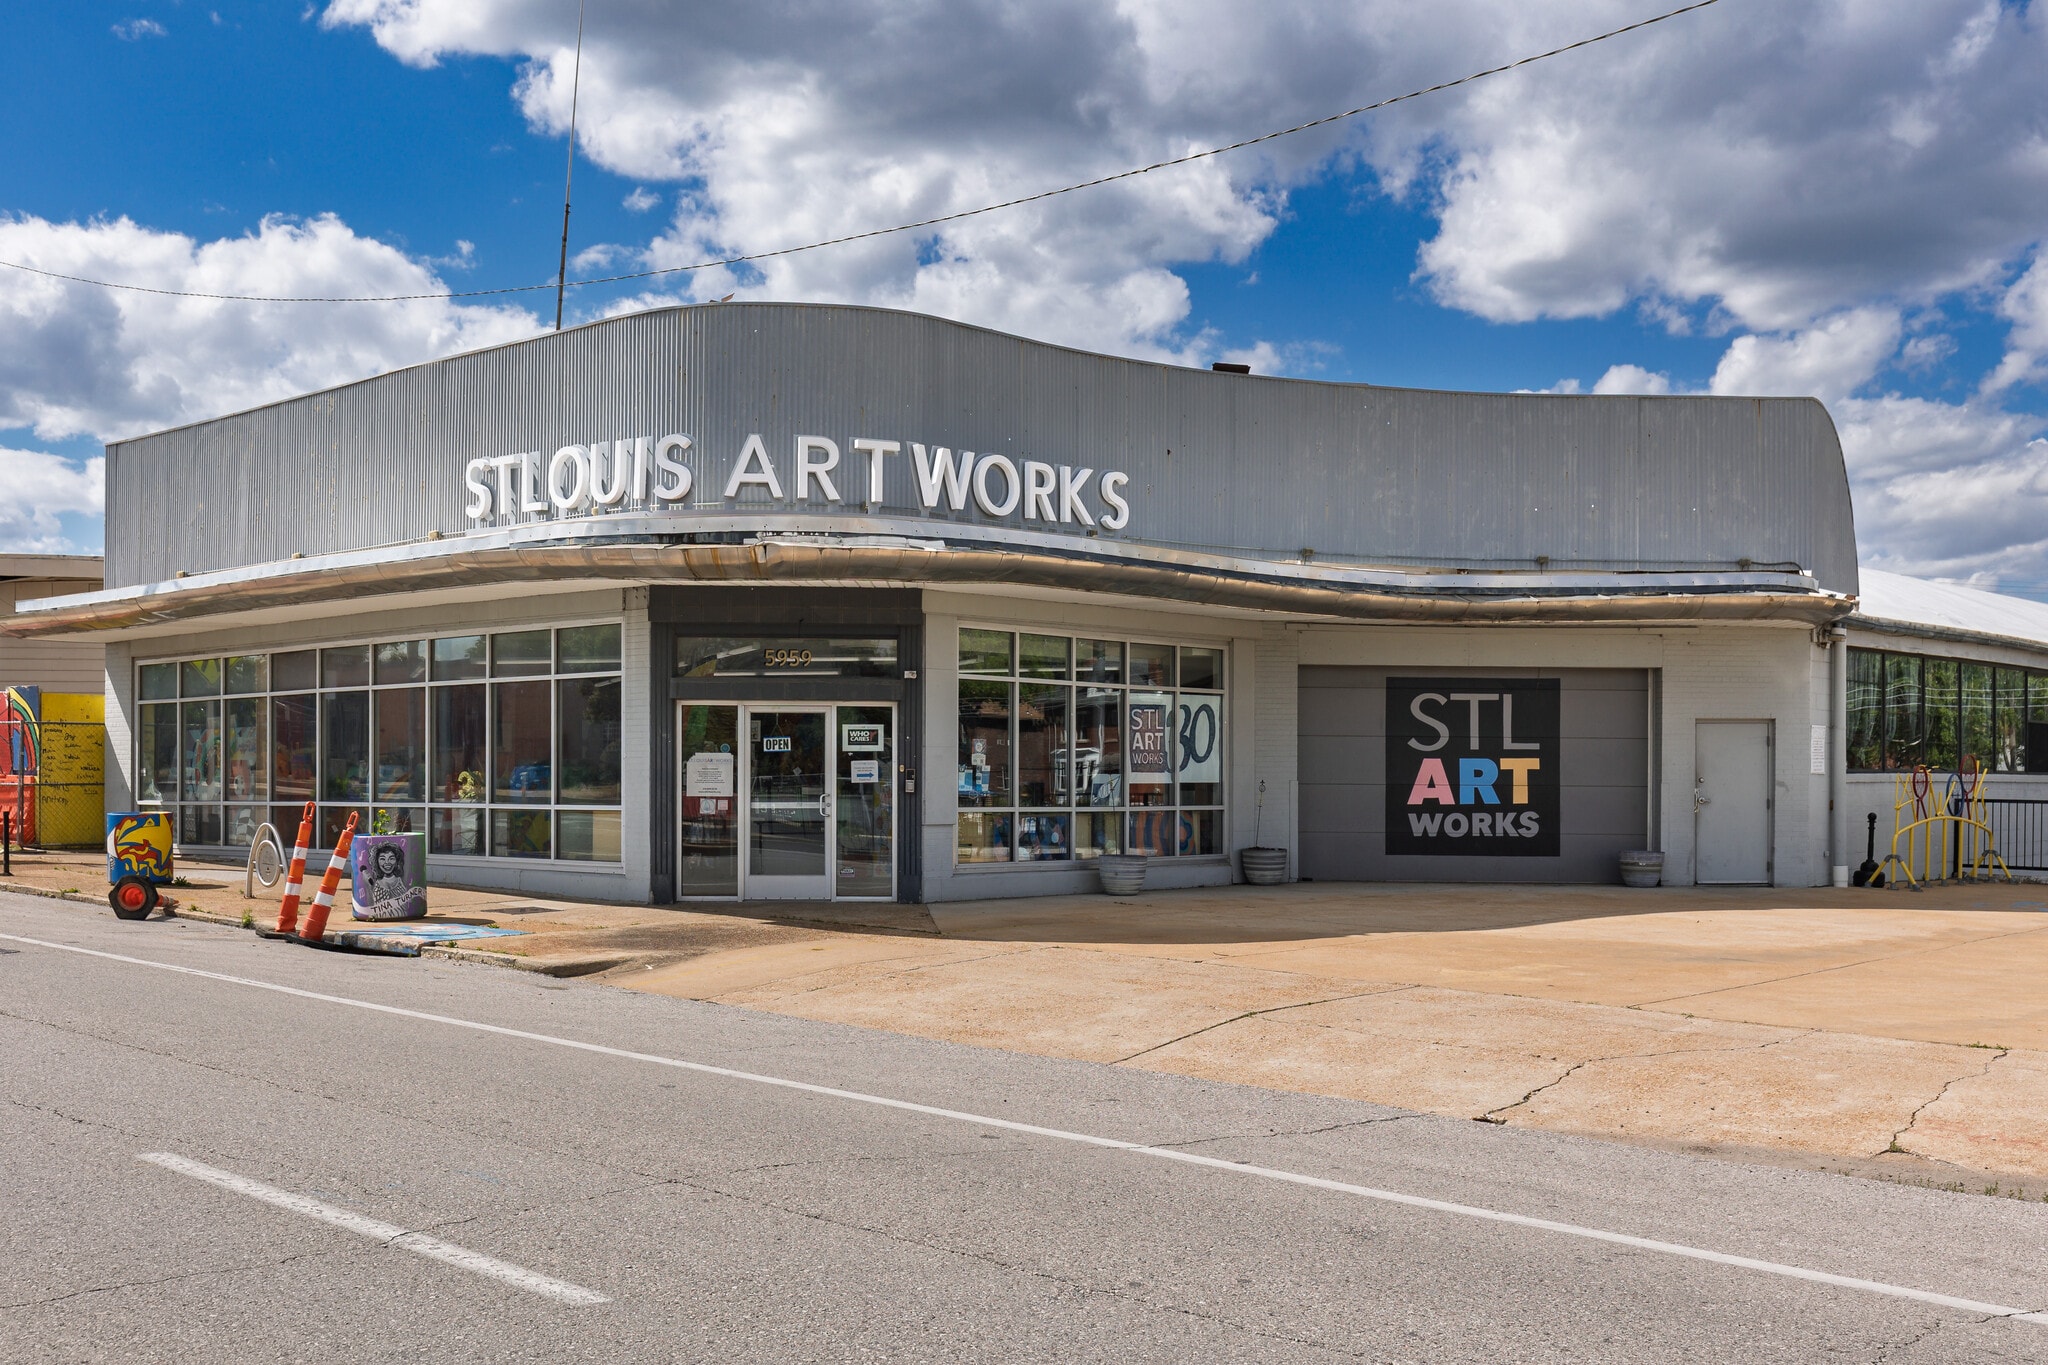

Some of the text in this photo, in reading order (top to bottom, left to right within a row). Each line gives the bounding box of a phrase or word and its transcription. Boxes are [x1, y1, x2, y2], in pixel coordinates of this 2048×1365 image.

[764, 648, 813, 667] 5959
[1131, 708, 1164, 730] STL
[1407, 692, 1540, 752] STL
[765, 738, 790, 750] OPEN
[1132, 732, 1164, 751] ART
[1133, 752, 1164, 765] WORKS
[1407, 757, 1541, 806] ART
[1407, 811, 1541, 839] WORKS
[370, 901, 393, 914] TINA
